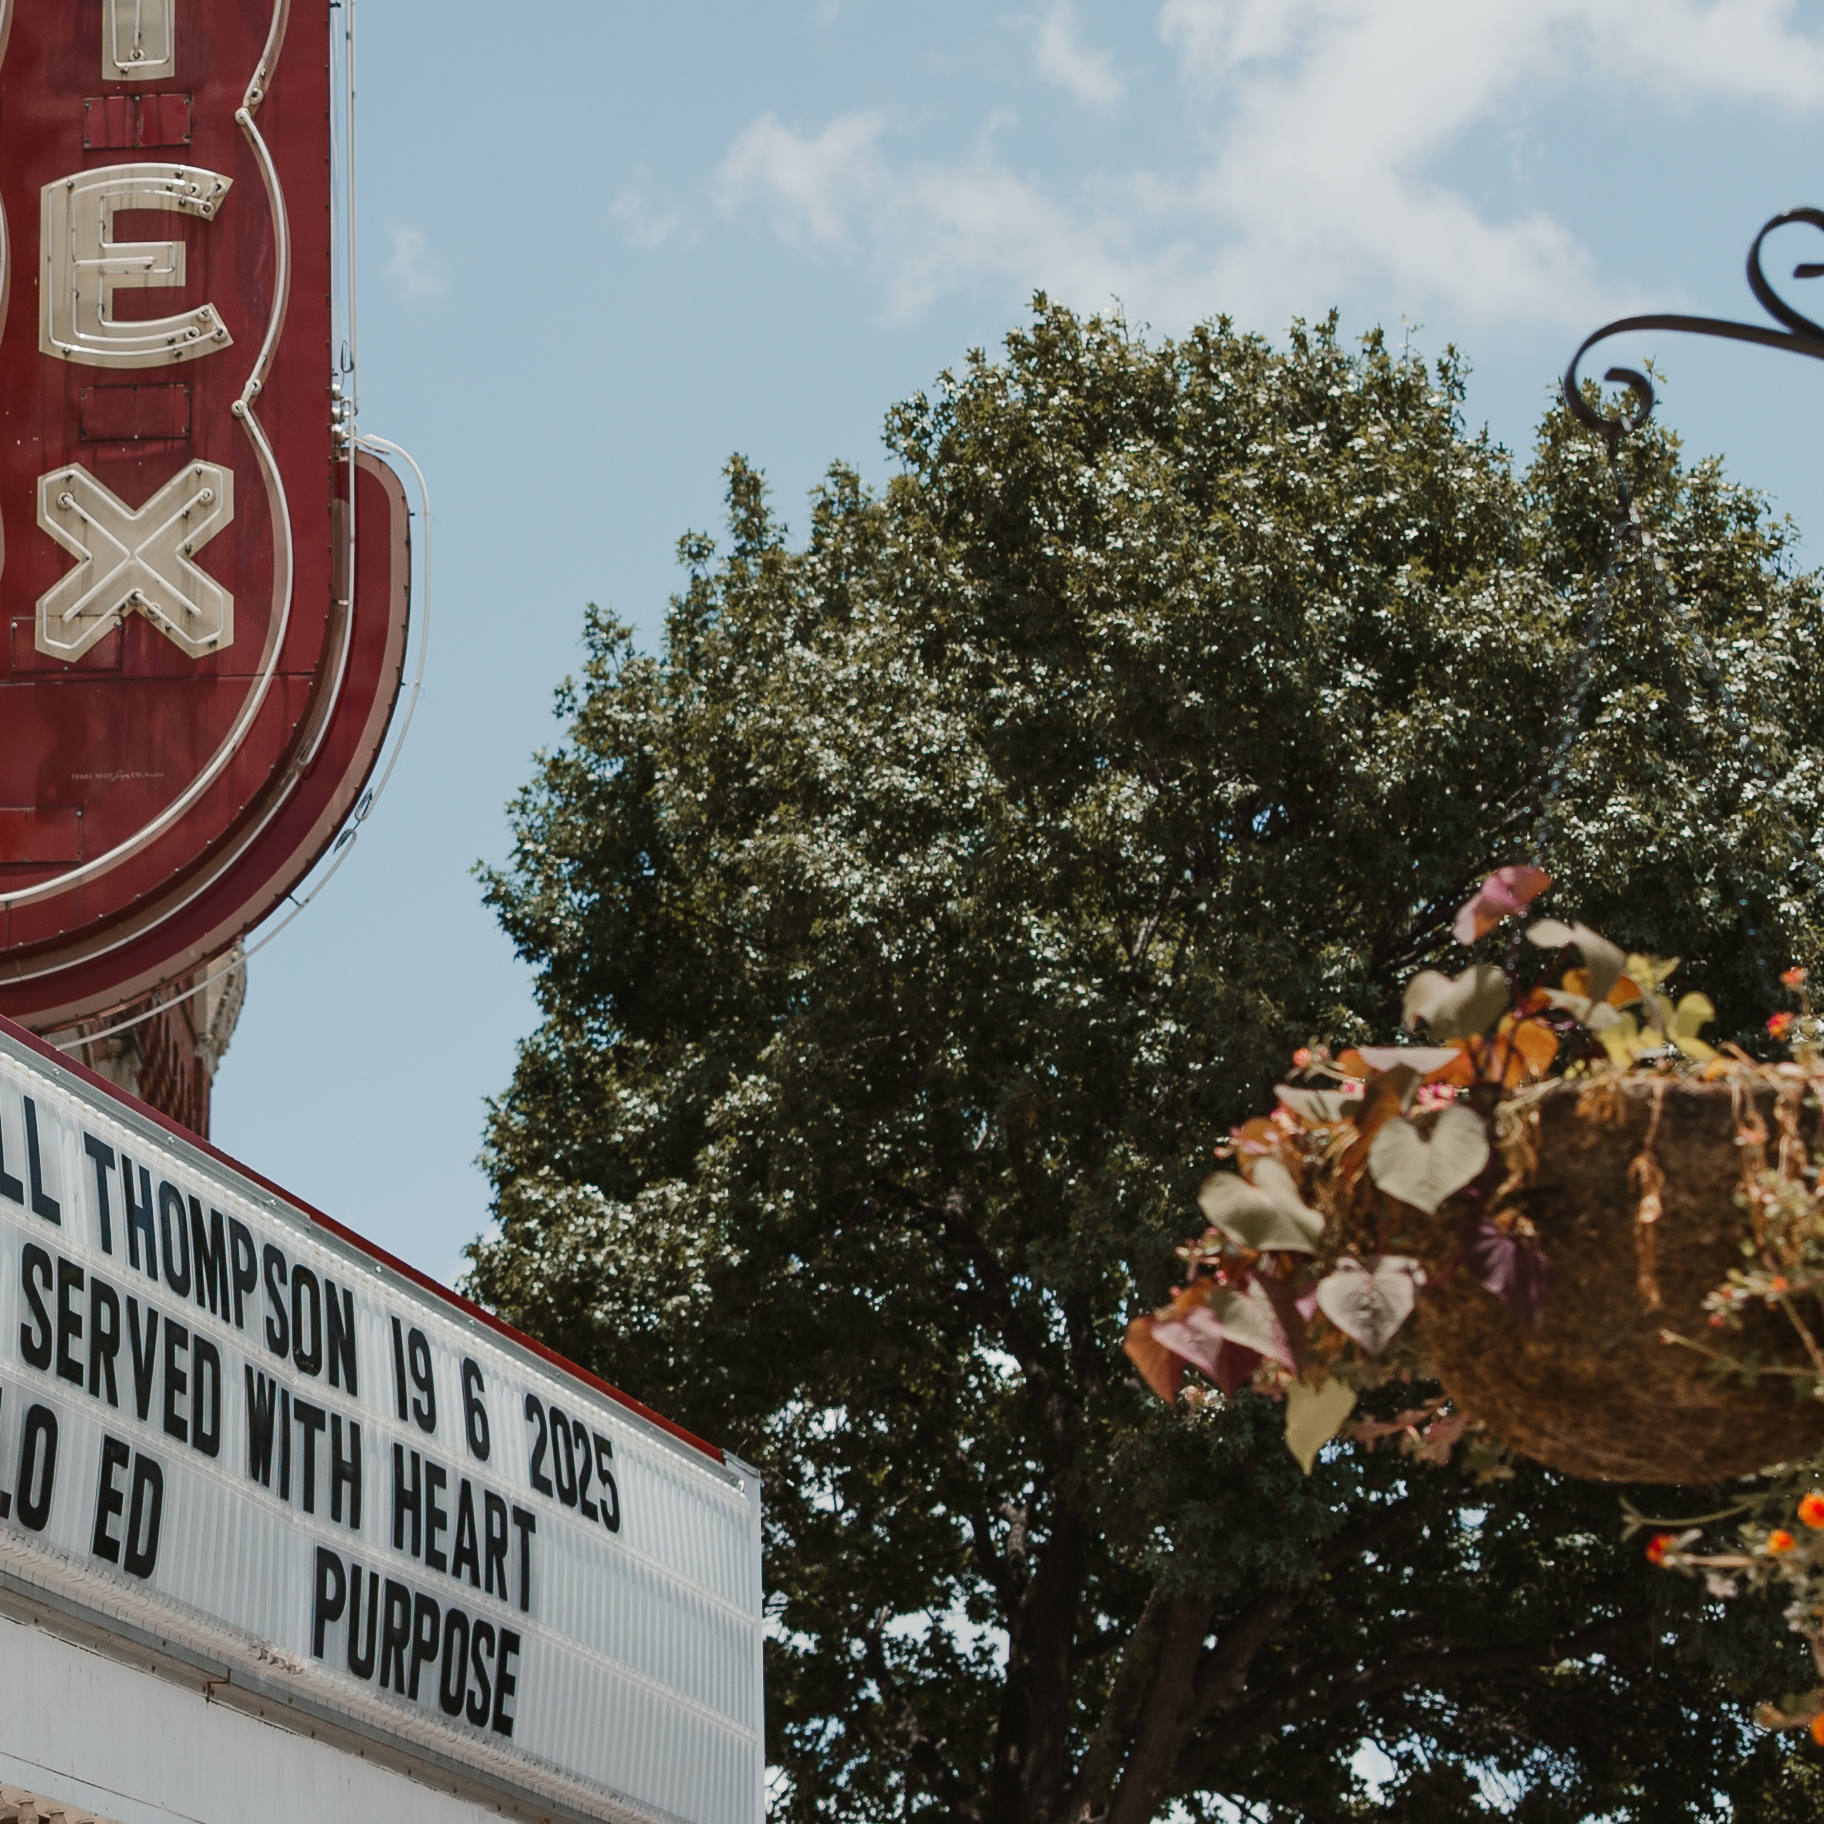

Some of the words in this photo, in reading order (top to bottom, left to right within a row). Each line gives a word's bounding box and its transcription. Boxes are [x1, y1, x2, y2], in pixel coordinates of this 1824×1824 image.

[19, 1242, 221, 1458] SERVED
[244, 1364, 361, 1529] WITH
[392, 1443, 536, 1612] HEART
[84, 1132, 358, 1397] THOMPSON
[391, 1316, 437, 1435] 19
[462, 1357, 491, 1461] 6
[524, 1394, 620, 1534] 2025
[313, 1546, 521, 1738] PURPOSE
